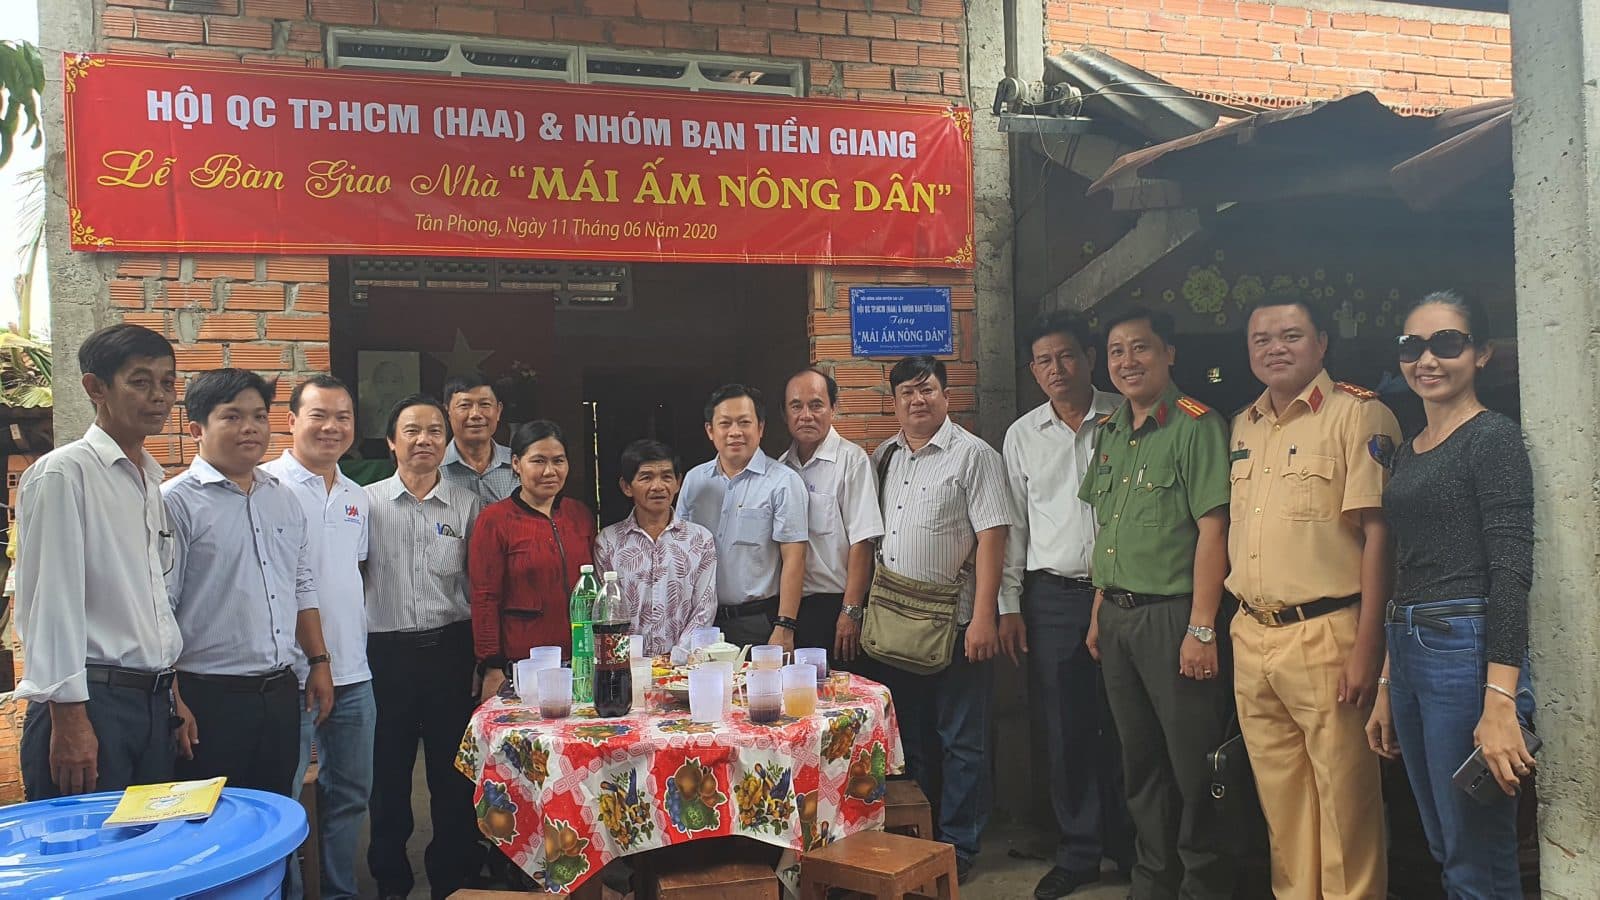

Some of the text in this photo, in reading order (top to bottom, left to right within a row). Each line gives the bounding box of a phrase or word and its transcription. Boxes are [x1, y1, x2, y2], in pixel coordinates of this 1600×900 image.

[146, 85, 917, 159] HỘI QC TP.HCM (HAA) & NHÓM BẠN TIỀN GIANG
[97, 149, 177, 188] Lễ
[190, 153, 285, 190] Bàn
[305, 159, 391, 199] Giao
[410, 163, 501, 198] Nhà
[633, 157, 706, 206] ẤM
[719, 167, 841, 211] NÔNG
[415, 213, 718, 241] Tân Phong, Ngày 11 Tháng 06 Năm 2020
[881, 326, 895, 343] ẤM
[897, 327, 923, 343] NÔNG
